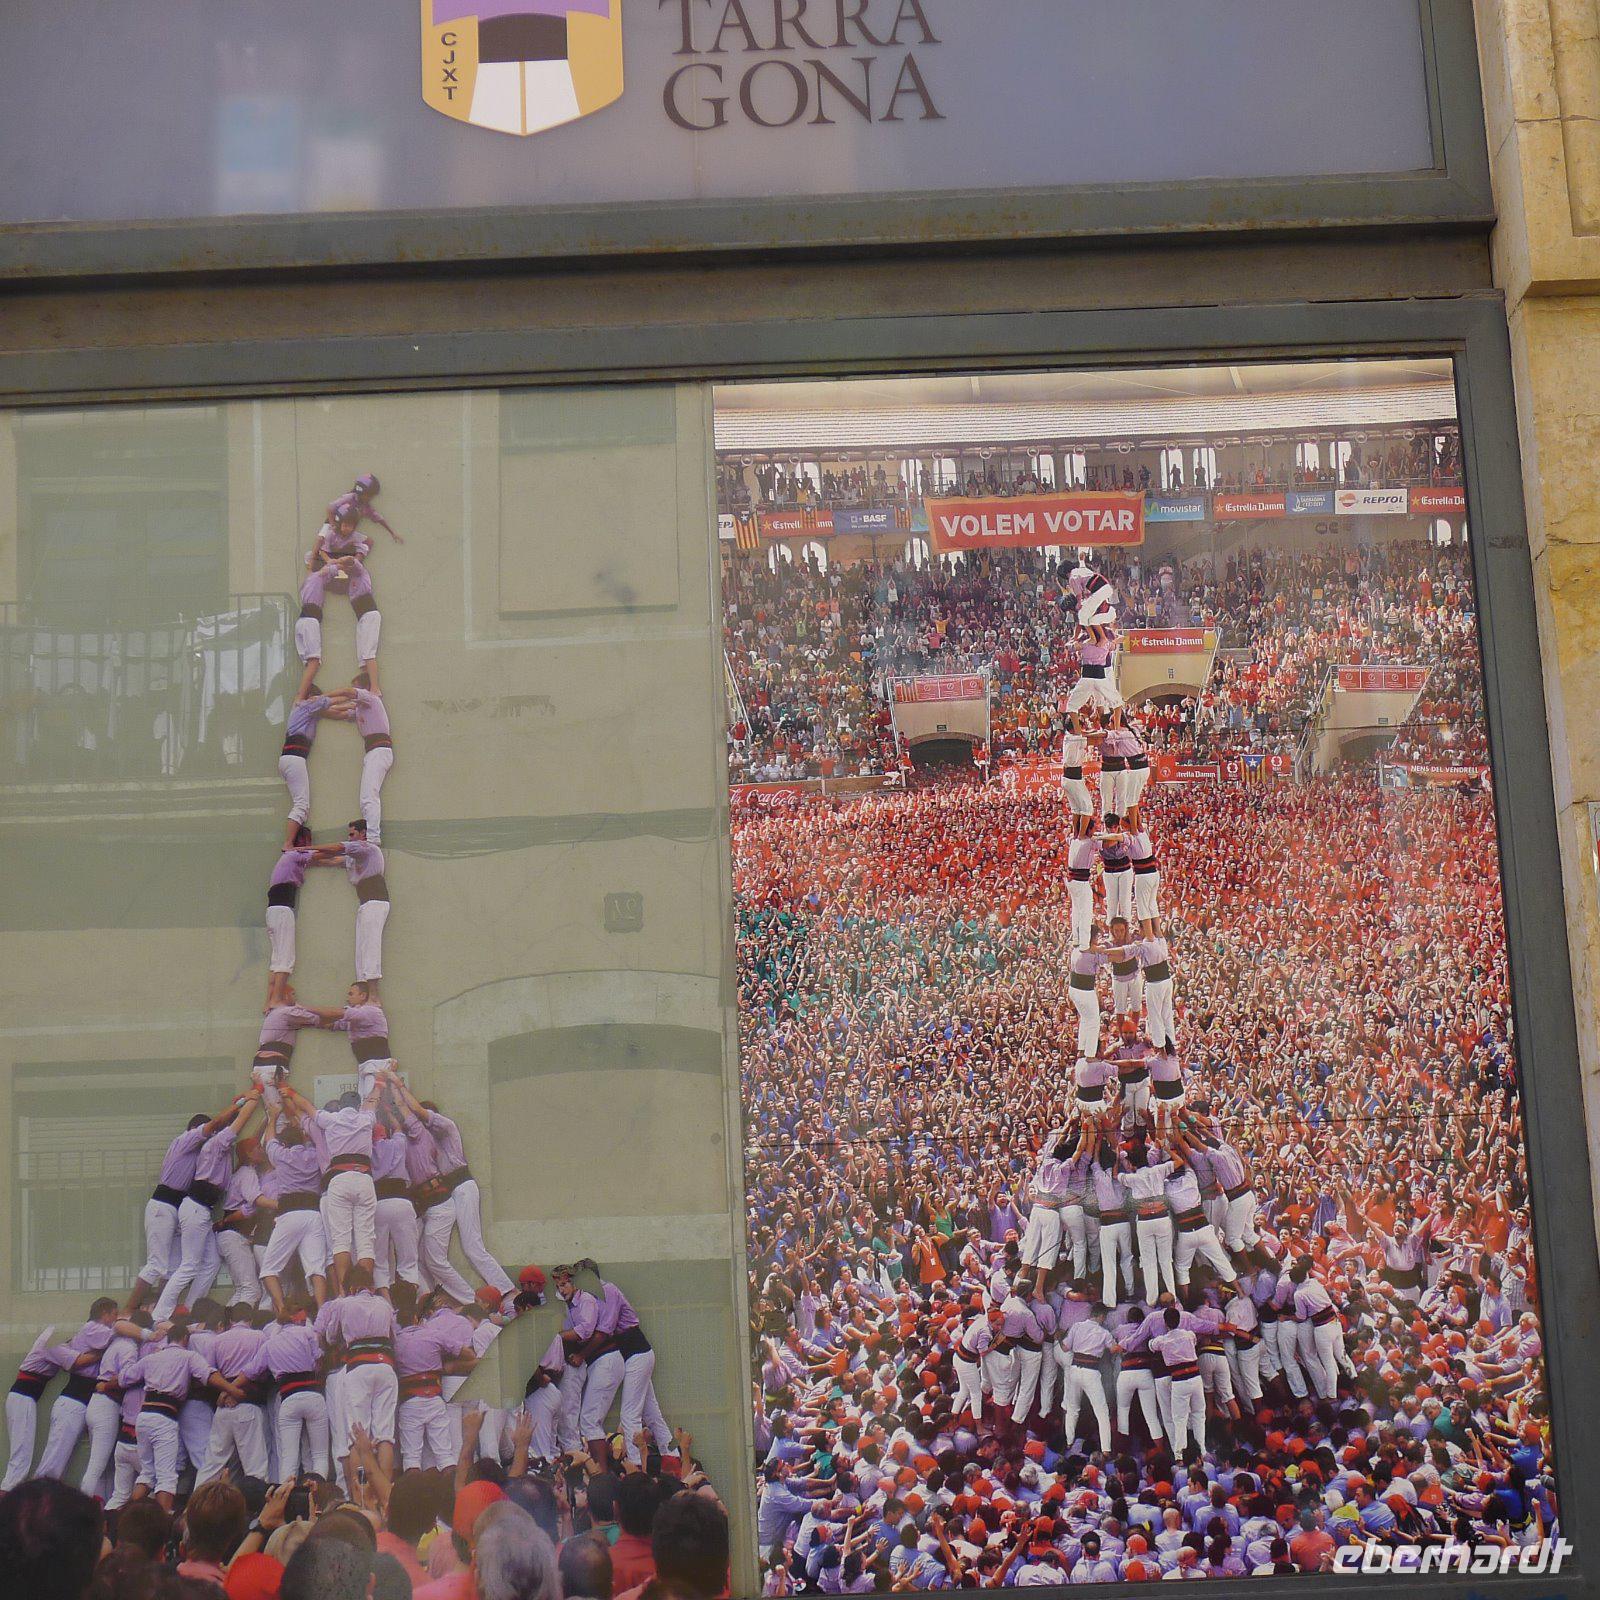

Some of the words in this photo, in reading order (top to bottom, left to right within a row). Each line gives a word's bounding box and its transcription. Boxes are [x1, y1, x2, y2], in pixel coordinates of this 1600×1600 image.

[658, 0, 942, 54] TARRA
[440, 32, 458, 100] CJXT
[662, 51, 946, 131] GONA
[1363, 495, 1404, 504] REPSOL
[1421, 495, 1454, 505] Estrella
[1454, 495, 1465, 505] Da
[1160, 503, 1201, 514] movistar
[1225, 502, 1257, 512] Estrella
[1258, 502, 1285, 511] Damm
[863, 514, 887, 523] BASF
[939, 512, 1035, 537] VOLEM
[1043, 509, 1135, 533] VOTAR
[772, 519, 800, 530] Estrell
[1141, 636, 1175, 647] Estrella
[1175, 637, 1203, 646] Damm
[1195, 770, 1216, 778] Damm
[1446, 766, 1479, 774] VENDRELL
